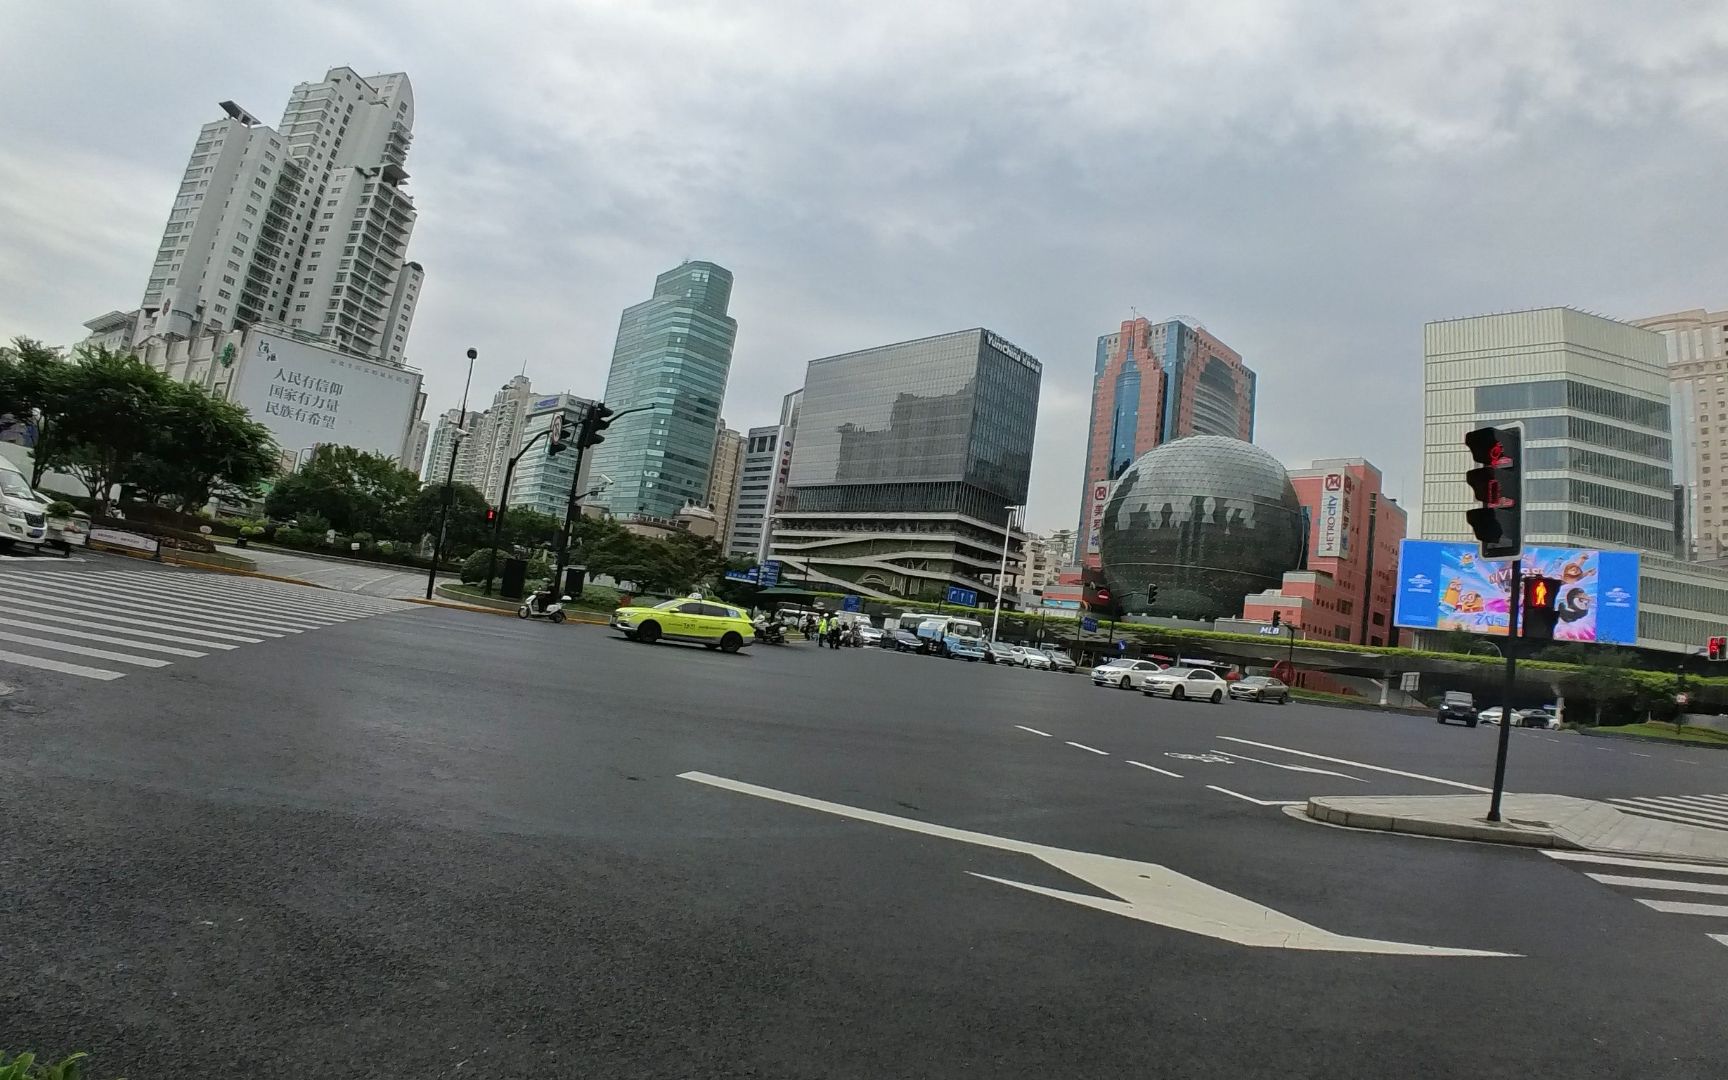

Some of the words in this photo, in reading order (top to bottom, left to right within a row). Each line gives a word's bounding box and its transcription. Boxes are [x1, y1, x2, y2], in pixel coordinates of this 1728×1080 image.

[273, 367, 343, 396] 人民有信仰
[269, 384, 339, 413] 国家有力量
[265, 401, 336, 429] 民族有希望
